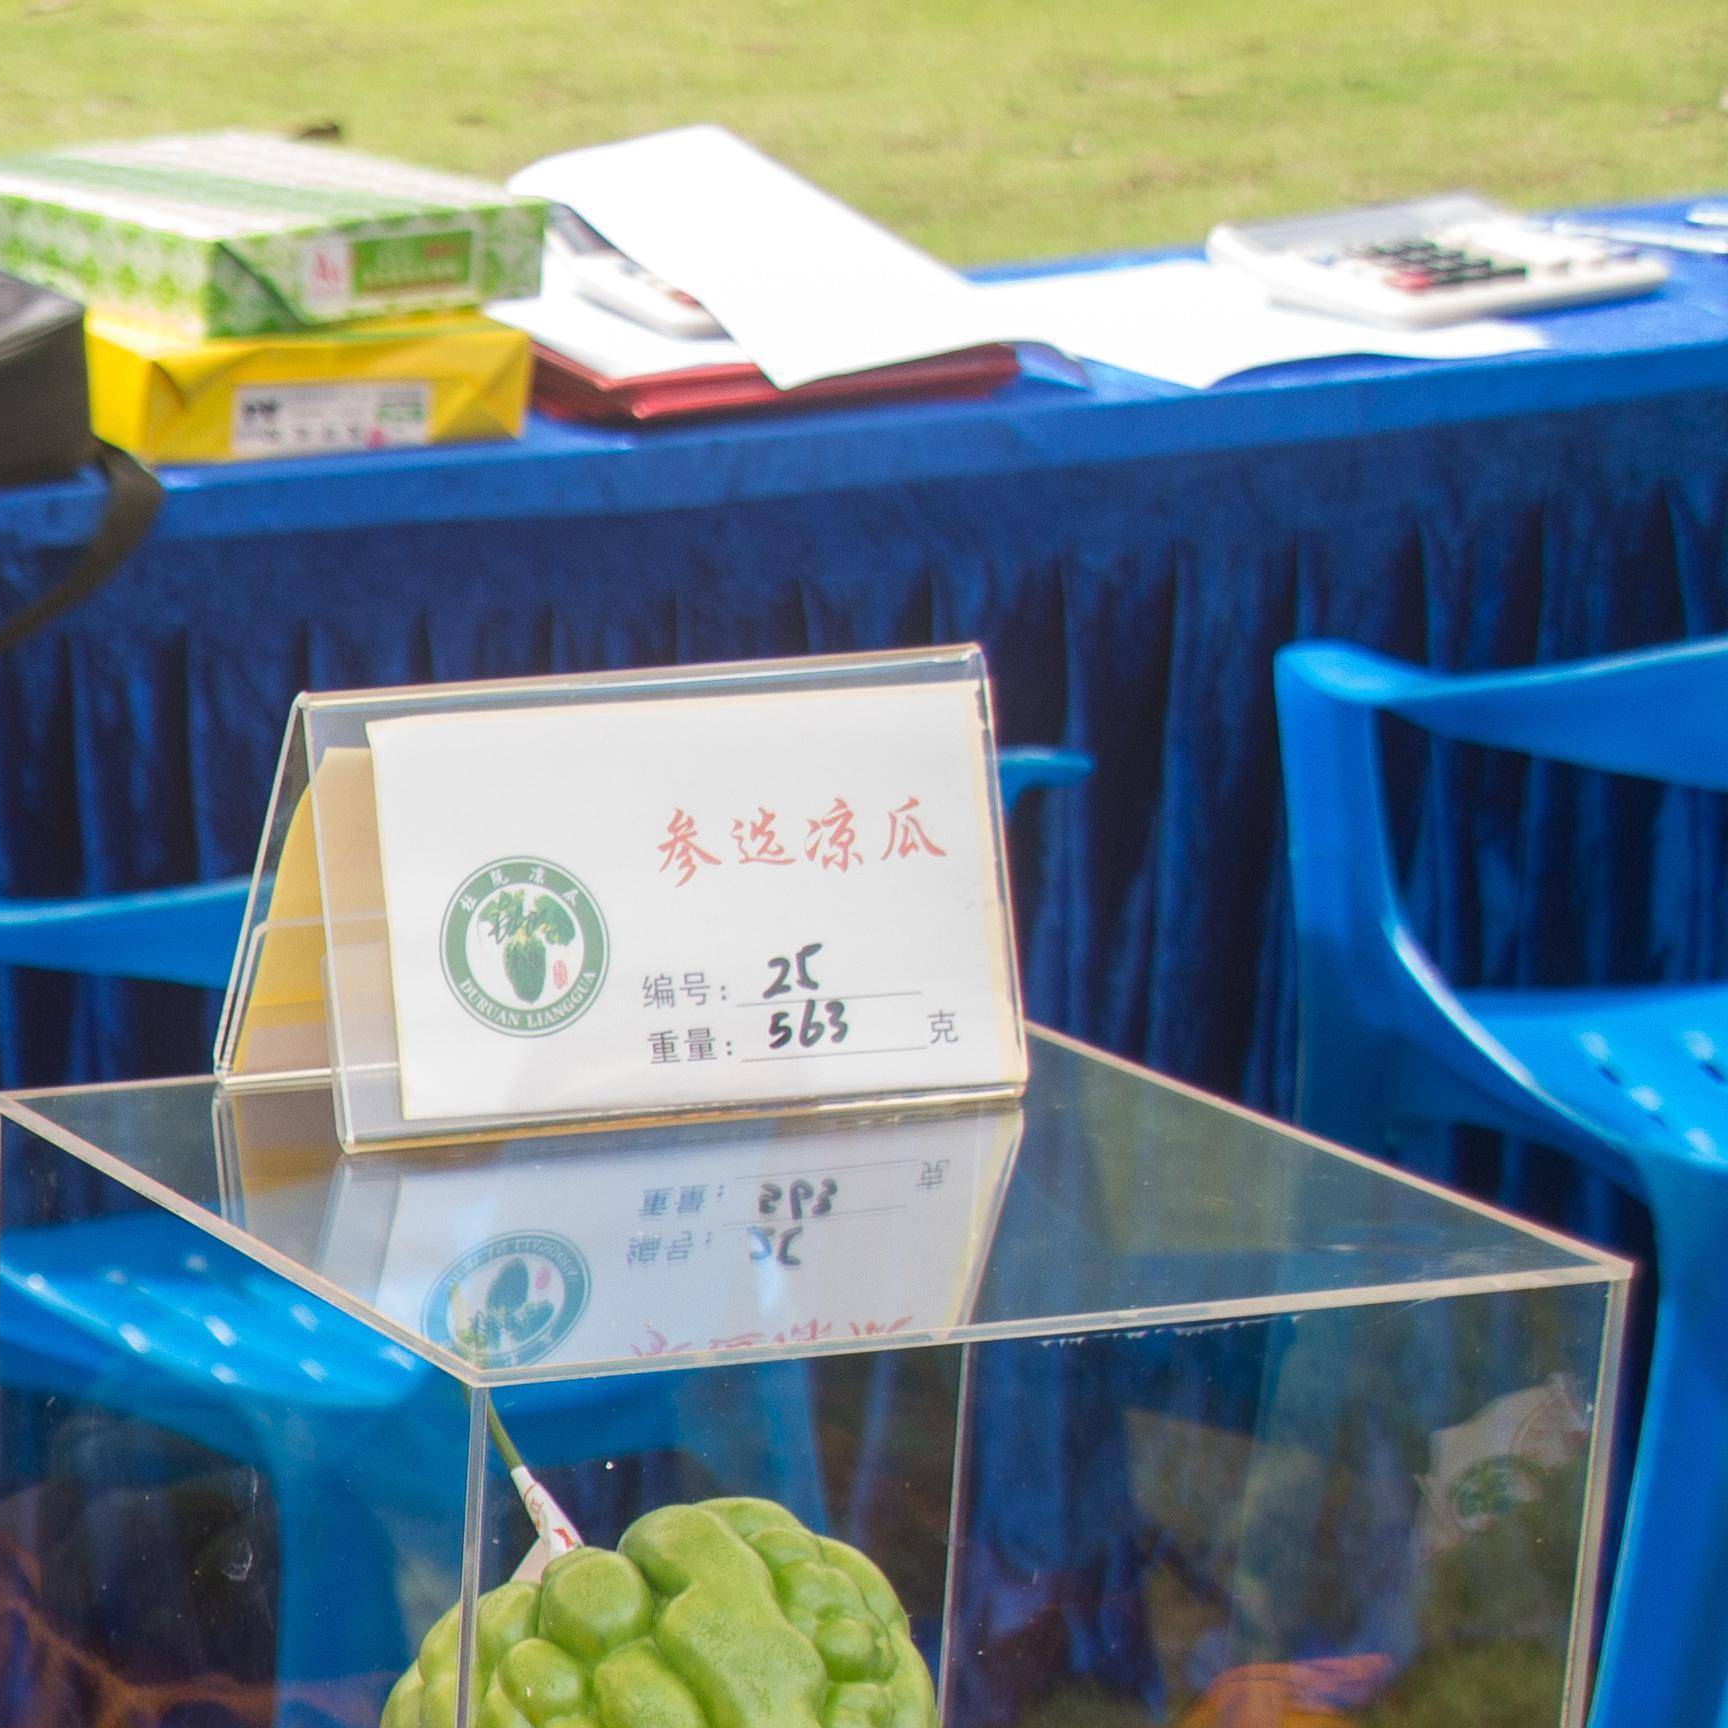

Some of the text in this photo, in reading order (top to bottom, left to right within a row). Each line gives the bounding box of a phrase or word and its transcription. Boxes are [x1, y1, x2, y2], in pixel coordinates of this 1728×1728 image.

[657, 797, 946, 887] 参选凉瓜
[762, 943, 822, 999] 25
[458, 980, 519, 1026] DURUAN
[527, 972, 596, 1028] LIANGGUA
[768, 1002, 848, 1050] 563
[927, 1011, 959, 1044] 克
